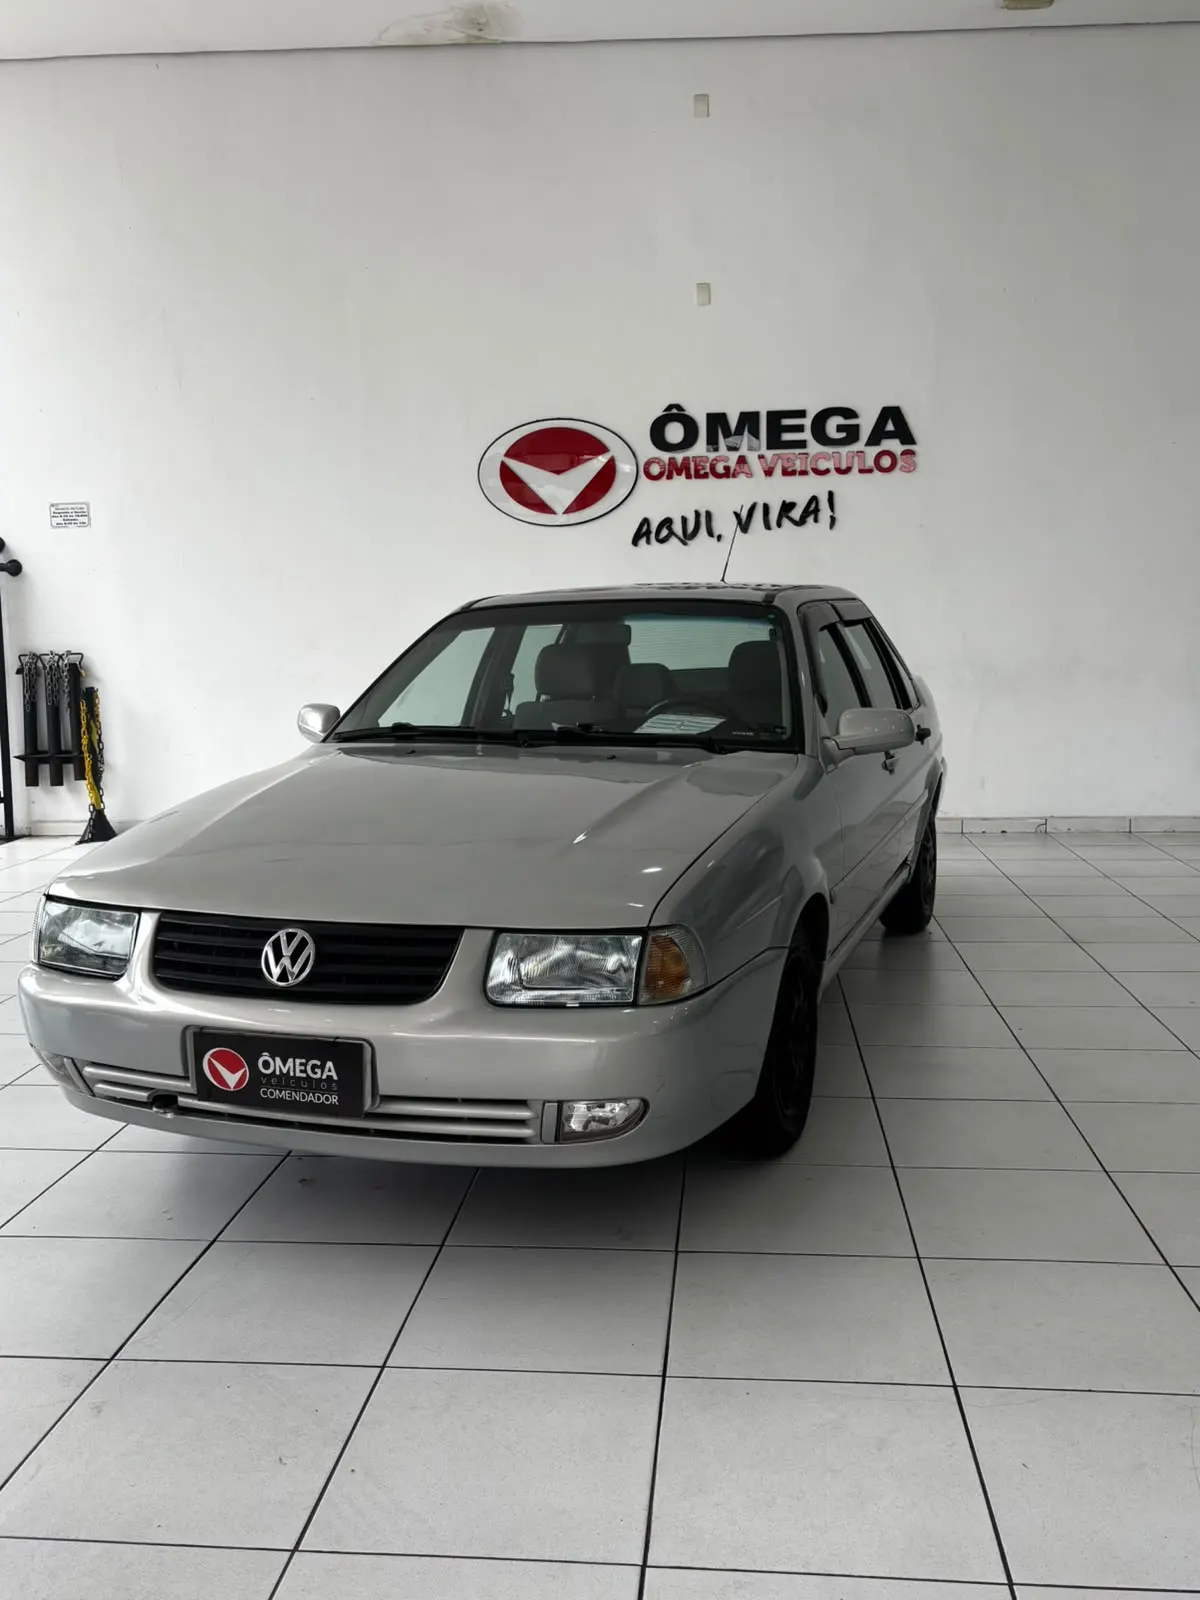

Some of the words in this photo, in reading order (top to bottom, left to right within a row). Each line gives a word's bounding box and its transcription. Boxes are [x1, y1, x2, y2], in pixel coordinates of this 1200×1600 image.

[649, 403, 917, 453] ÔMEGA
[643, 455, 752, 481] OMEGA
[733, 490, 836, 534] VIRA!
[258, 1052, 338, 1081] ÔMEGA
[260, 1088, 339, 1105] COMENDADOR
